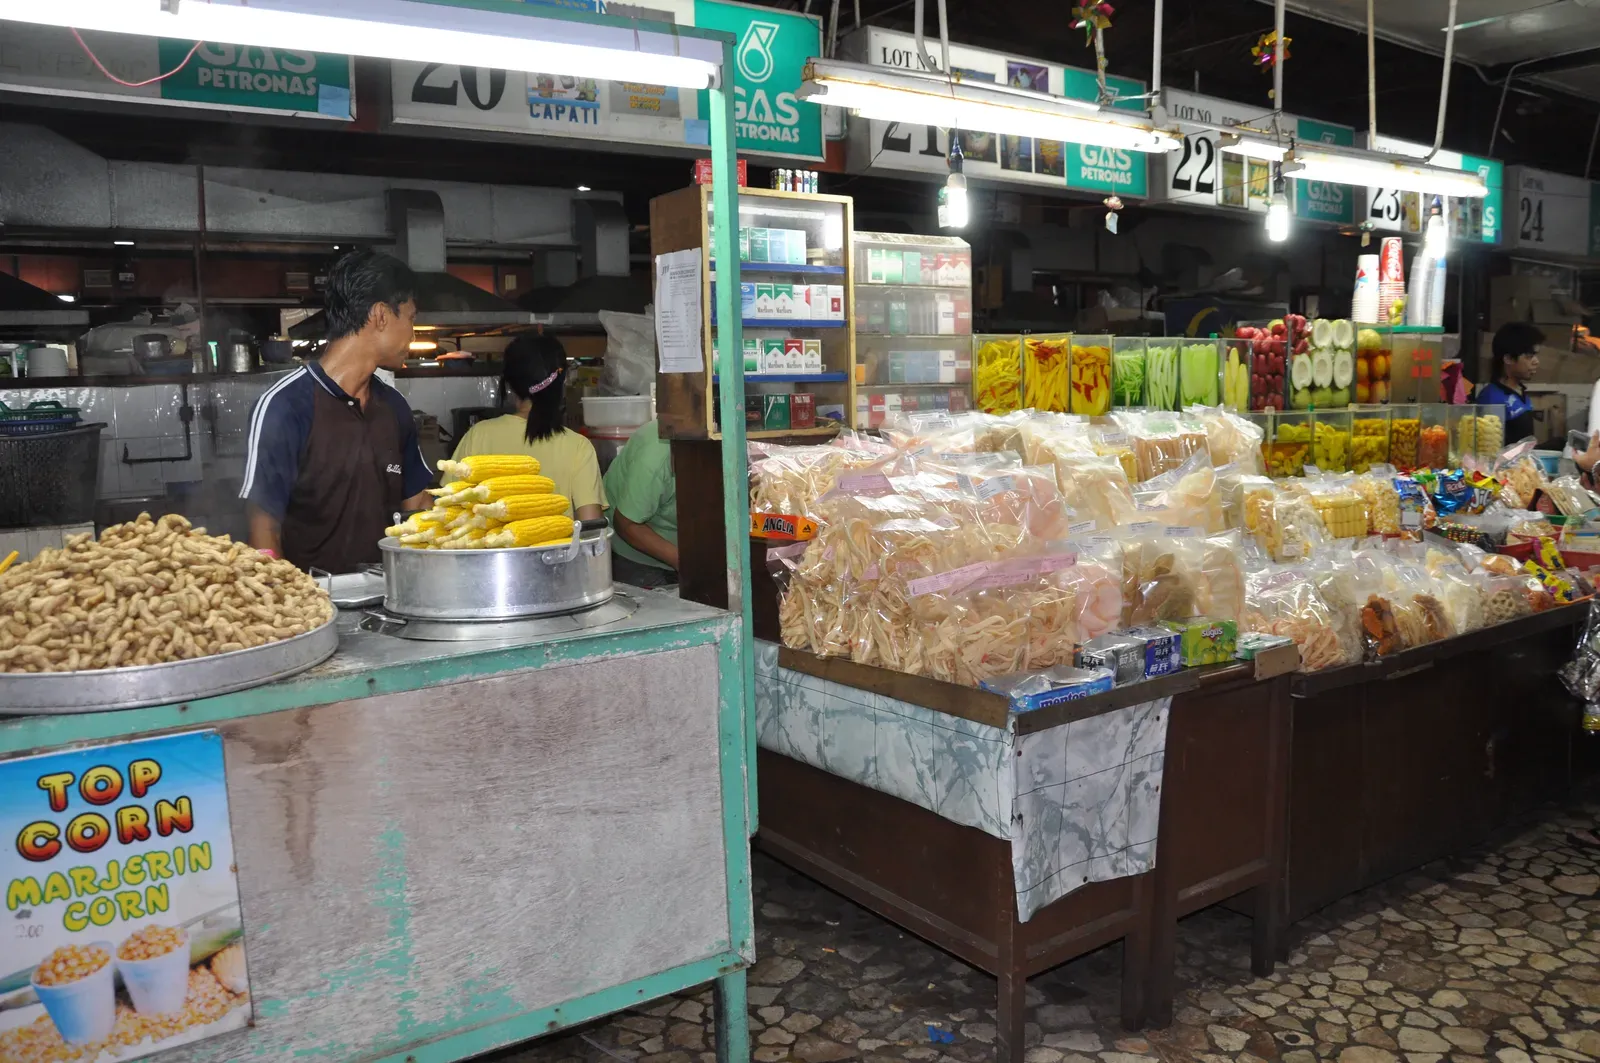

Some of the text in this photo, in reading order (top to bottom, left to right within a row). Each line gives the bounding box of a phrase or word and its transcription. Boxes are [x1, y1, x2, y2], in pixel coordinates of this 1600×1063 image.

[882, 46, 913, 69] LOT
[197, 67, 317, 97] PETRONAS
[529, 103, 598, 125] CAPATI
[734, 85, 800, 126] GAS
[1174, 103, 1194, 121] LOT
[735, 121, 800, 143] ETRONAS
[1081, 166, 1132, 185] PETRONAS
[1172, 135, 1215, 194] 22
[1520, 197, 1545, 243] 24
[762, 516, 795, 536] ANGLIA
[1201, 627, 1223, 640] sugus
[37, 757, 163, 813] TOP
[16, 795, 194, 862] CORN
[7, 841, 212, 911] MARJERIN
[63, 883, 170, 932] CORN
